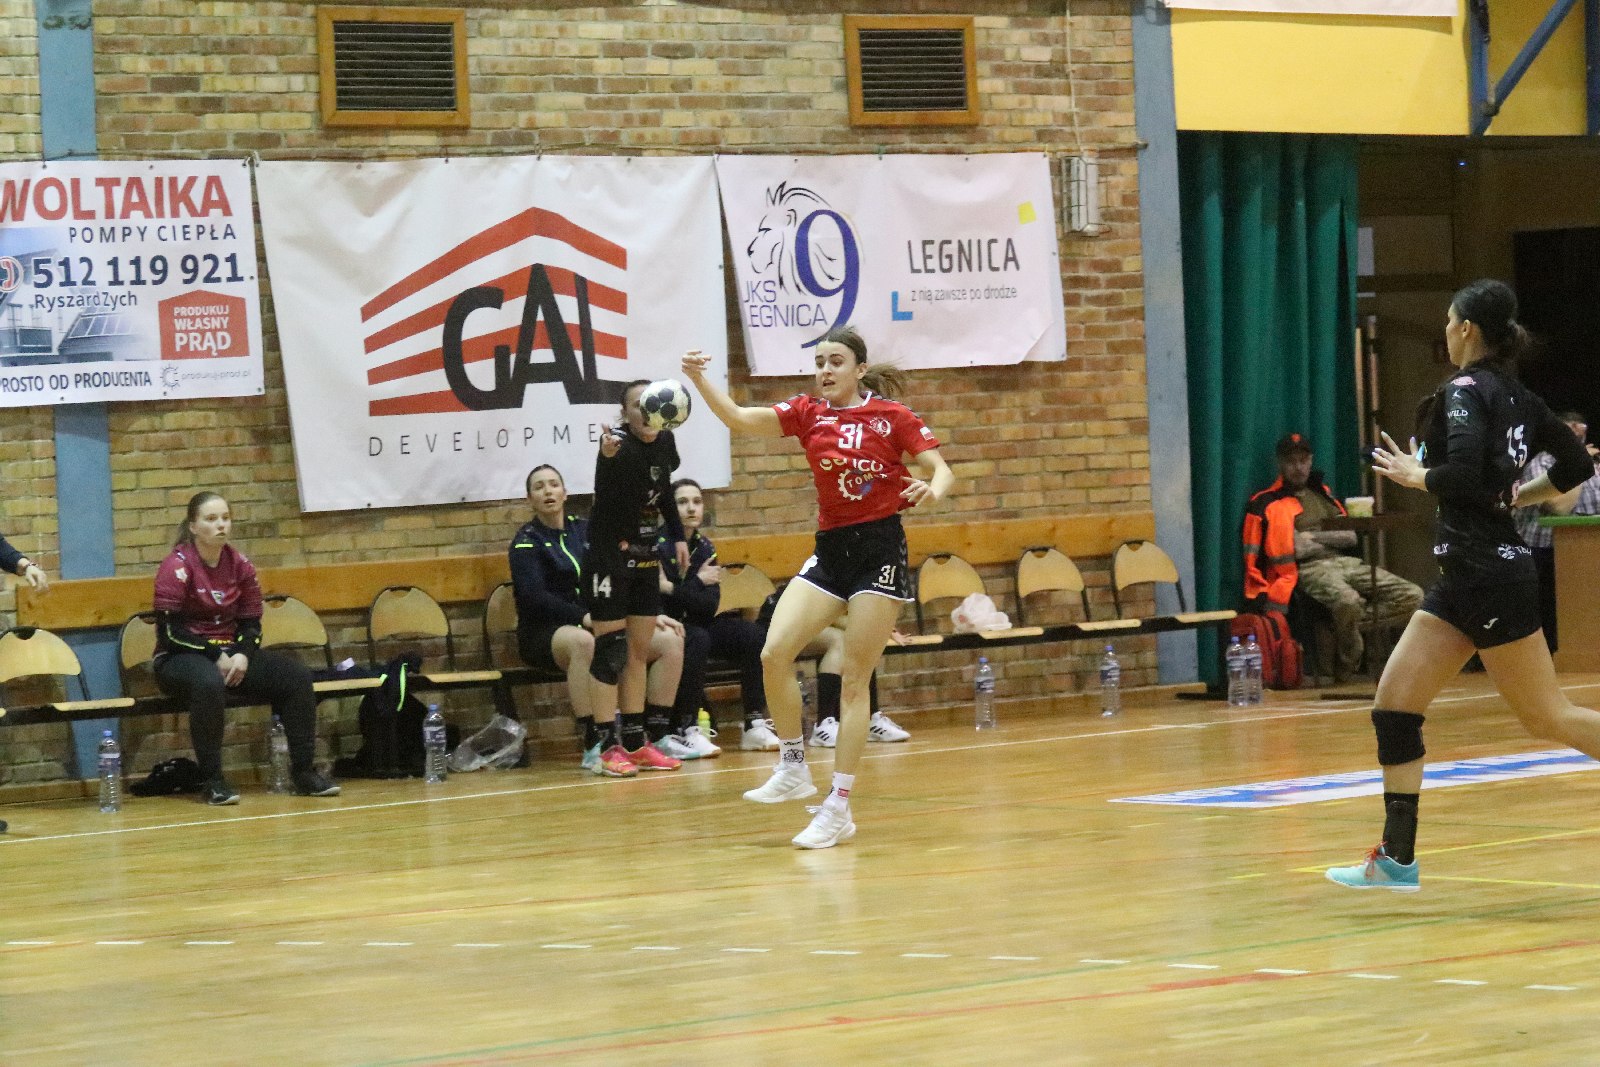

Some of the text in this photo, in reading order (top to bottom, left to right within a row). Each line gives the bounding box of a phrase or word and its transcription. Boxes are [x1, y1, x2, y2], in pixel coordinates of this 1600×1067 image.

[69, 223, 236, 243] POMPY CIEPŁA
[907, 238, 1020, 274] LEGNICA
[33, 252, 244, 288] 512 119 921
[983, 284, 1018, 300] drodze
[173, 305, 230, 317] PRODUKUJ
[747, 303, 828, 328] EGNICA
[175, 331, 232, 356] PRĄD
[442, 262, 624, 411] GAL
[0, 371, 152, 393] ROSTO OD PRODUCENTA
[369, 423, 599, 457] DEVELOPME
[838, 422, 864, 450] 31
[592, 572, 612, 598] 14
[878, 564, 897, 585] 31
